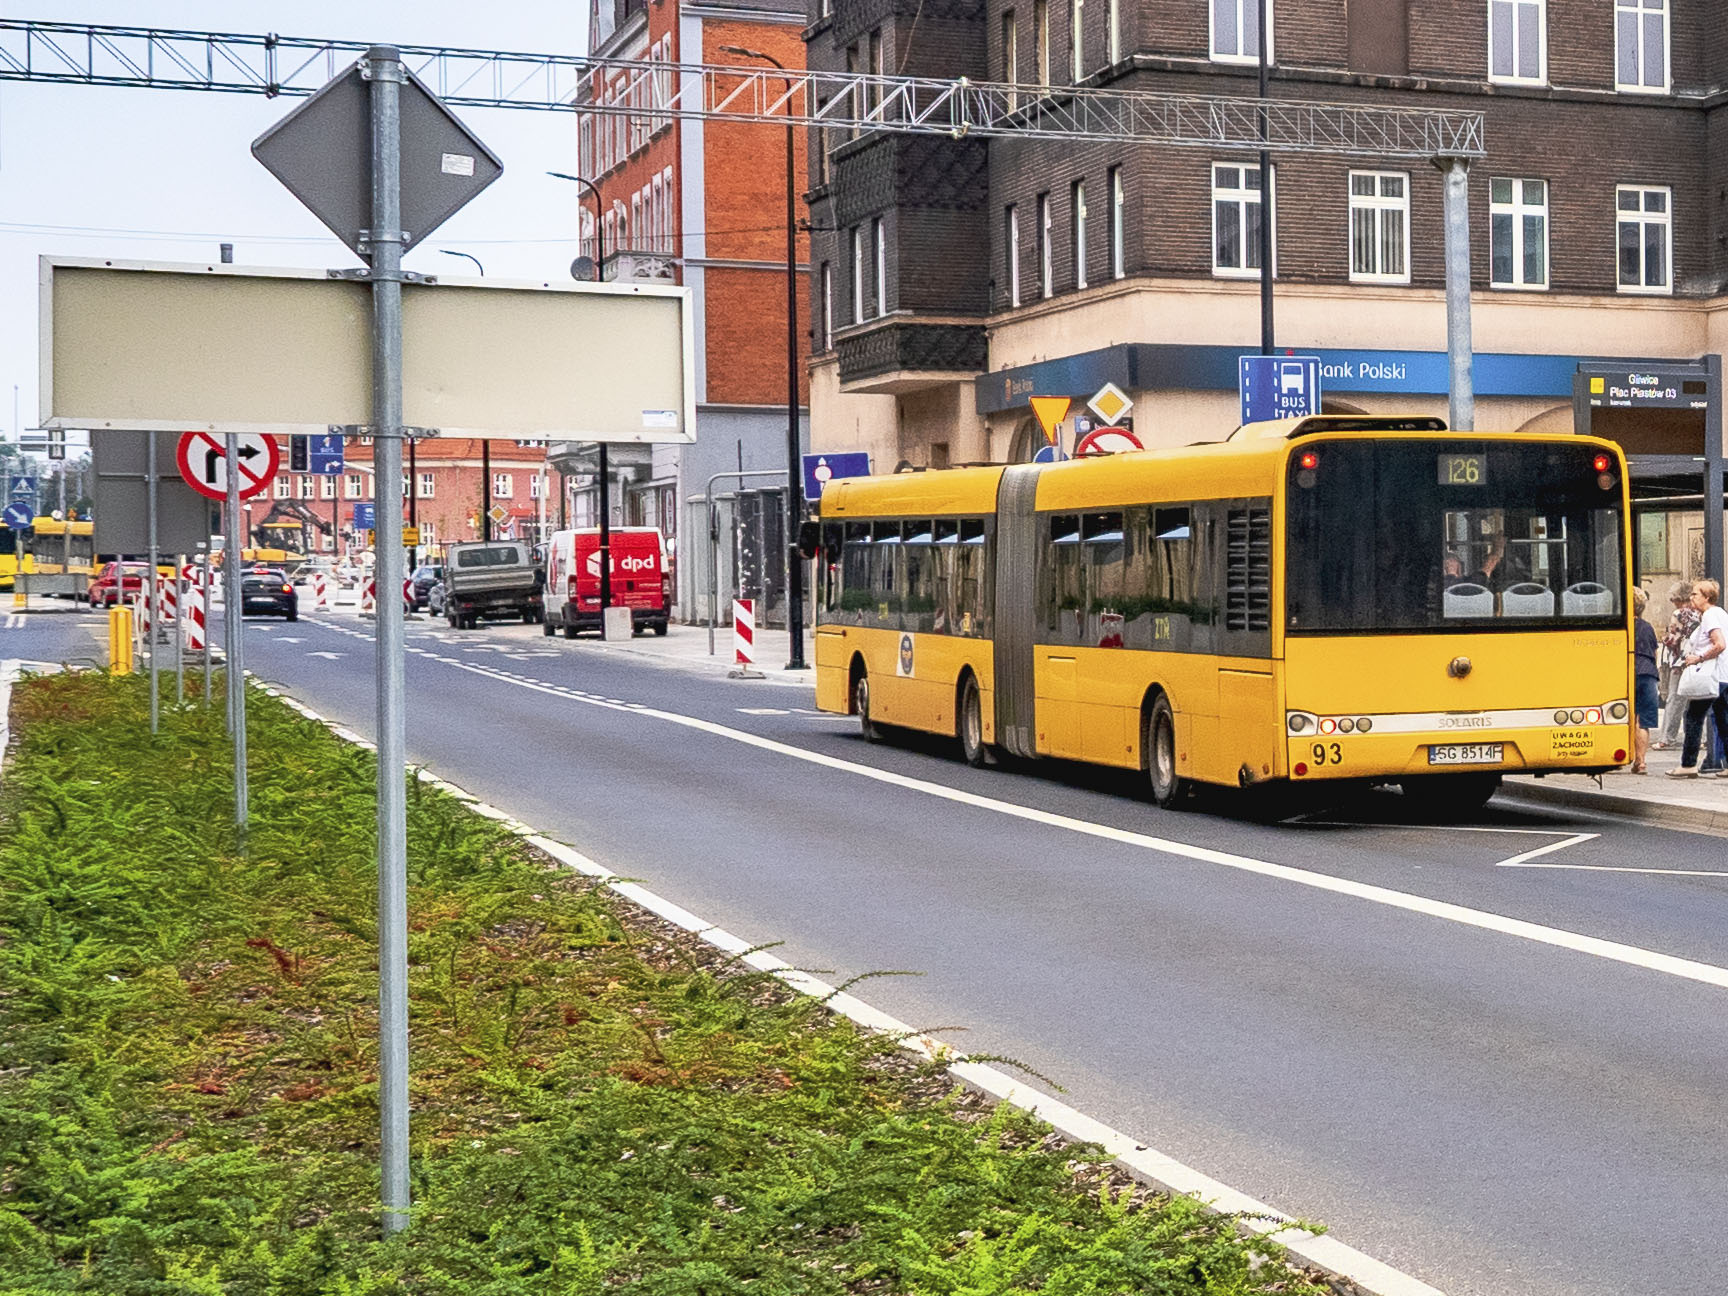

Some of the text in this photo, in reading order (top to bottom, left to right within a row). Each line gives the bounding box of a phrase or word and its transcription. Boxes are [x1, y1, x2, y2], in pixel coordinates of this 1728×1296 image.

[1359, 362, 1406, 380] Polski
[1665, 388, 1677, 399] 03
[1281, 396, 1306, 408] BUS
[1448, 458, 1479, 483] 126
[621, 554, 655, 572] dpd
[1438, 716, 1492, 728] SOLARIS
[1313, 742, 1343, 766] 93
[1437, 747, 1457, 760] SG
